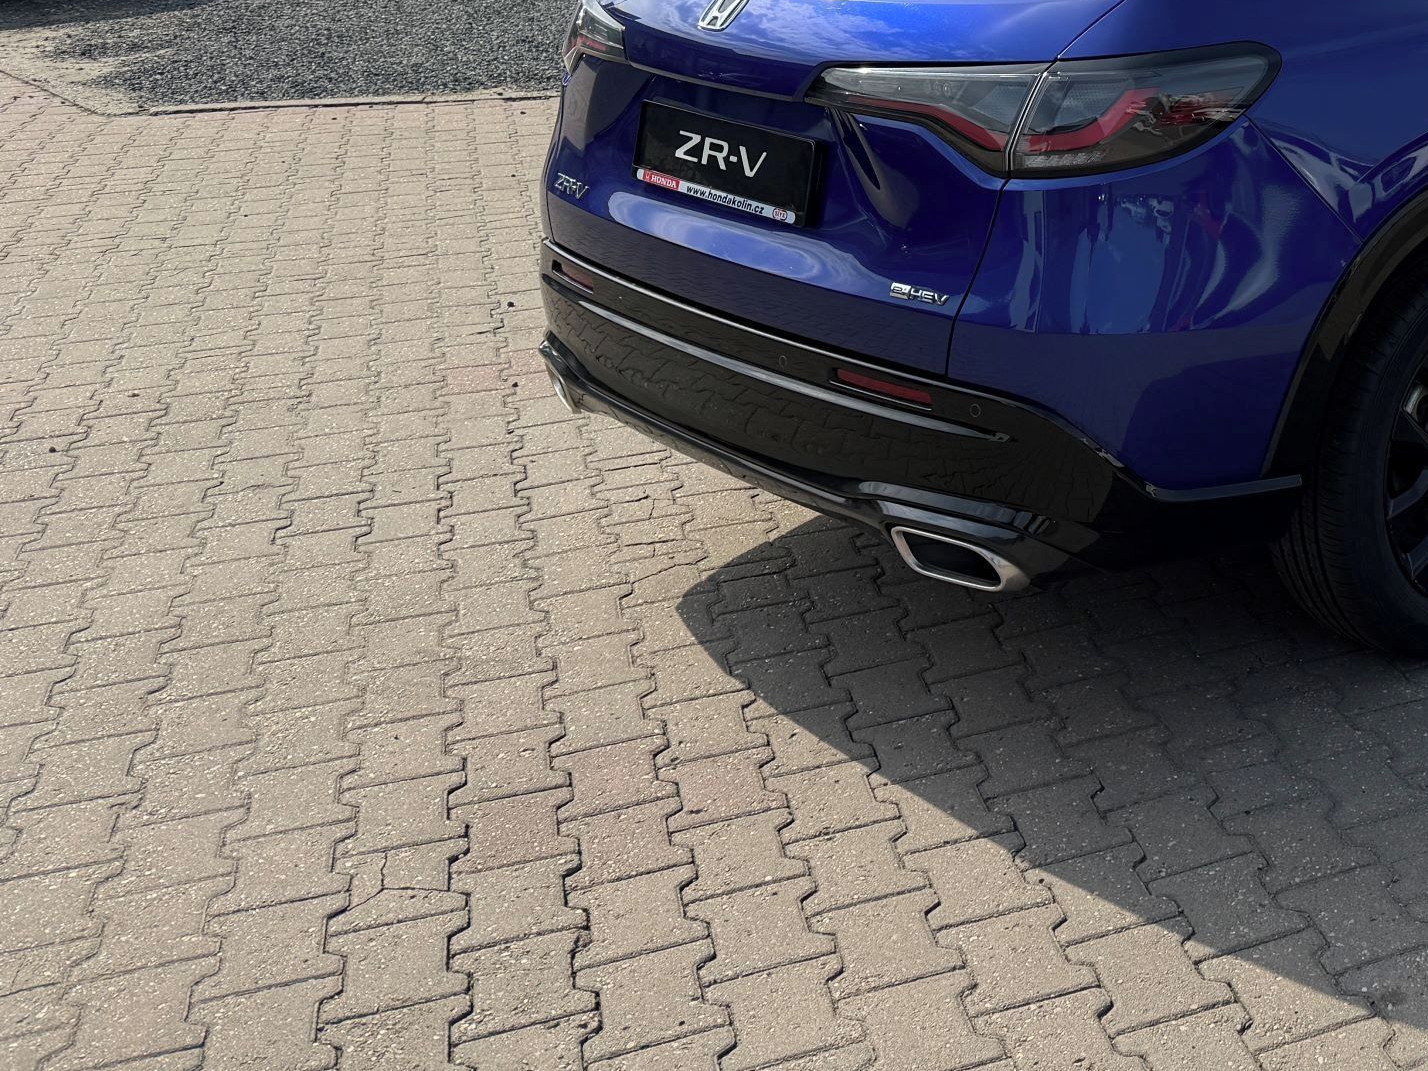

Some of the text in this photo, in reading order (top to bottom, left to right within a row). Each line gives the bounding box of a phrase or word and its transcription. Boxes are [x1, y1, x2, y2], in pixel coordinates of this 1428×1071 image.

[674, 130, 767, 178] ZR-V
[650, 174, 677, 189] HONDA
[686, 184, 764, 215] www.hondakolin.cz
